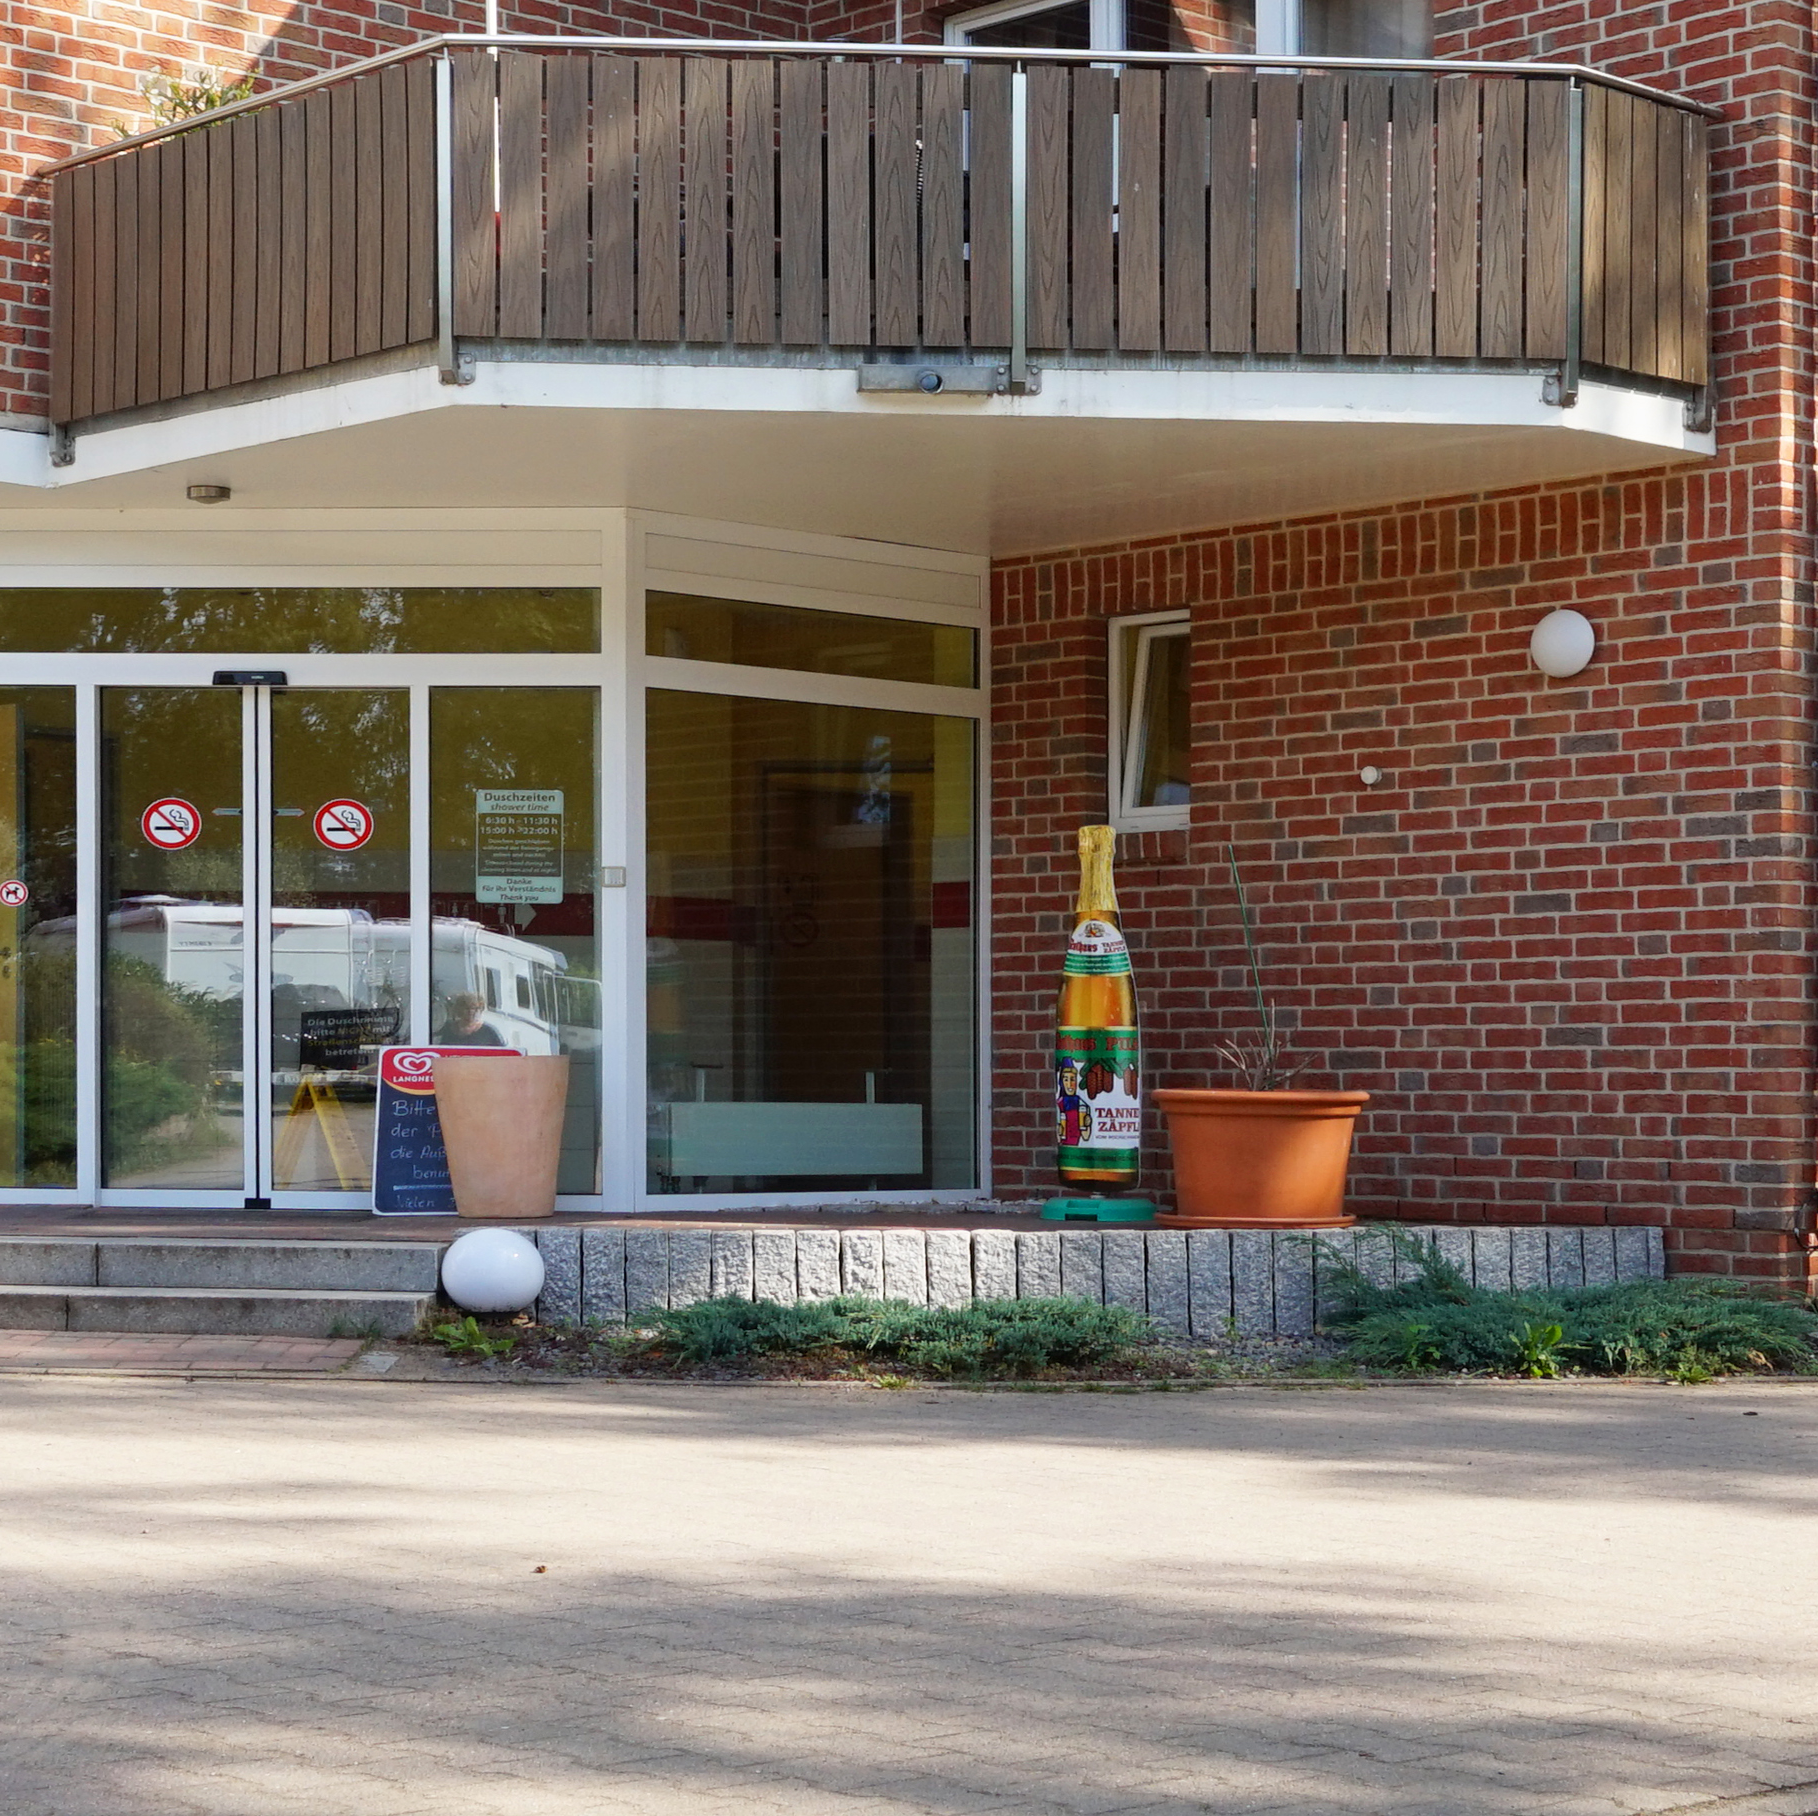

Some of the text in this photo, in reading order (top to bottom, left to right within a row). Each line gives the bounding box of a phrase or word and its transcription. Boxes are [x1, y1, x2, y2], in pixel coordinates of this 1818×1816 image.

[484, 792, 556, 802] Duschzeiten
[490, 803, 549, 811] shower time
[508, 816, 515, 824] h
[523, 816, 550, 824] 11:30
[551, 816, 558, 824] h
[480, 827, 507, 835] 15:00
[508, 826, 515, 834] h
[522, 827, 549, 835] 22:00
[551, 826, 558, 834] h
[309, 1028, 336, 1036] bitte
[372, 1025, 392, 1033] mit
[392, 1099, 436, 1117] Bitte
[391, 1123, 419, 1138] der
[390, 1145, 413, 1159] die
